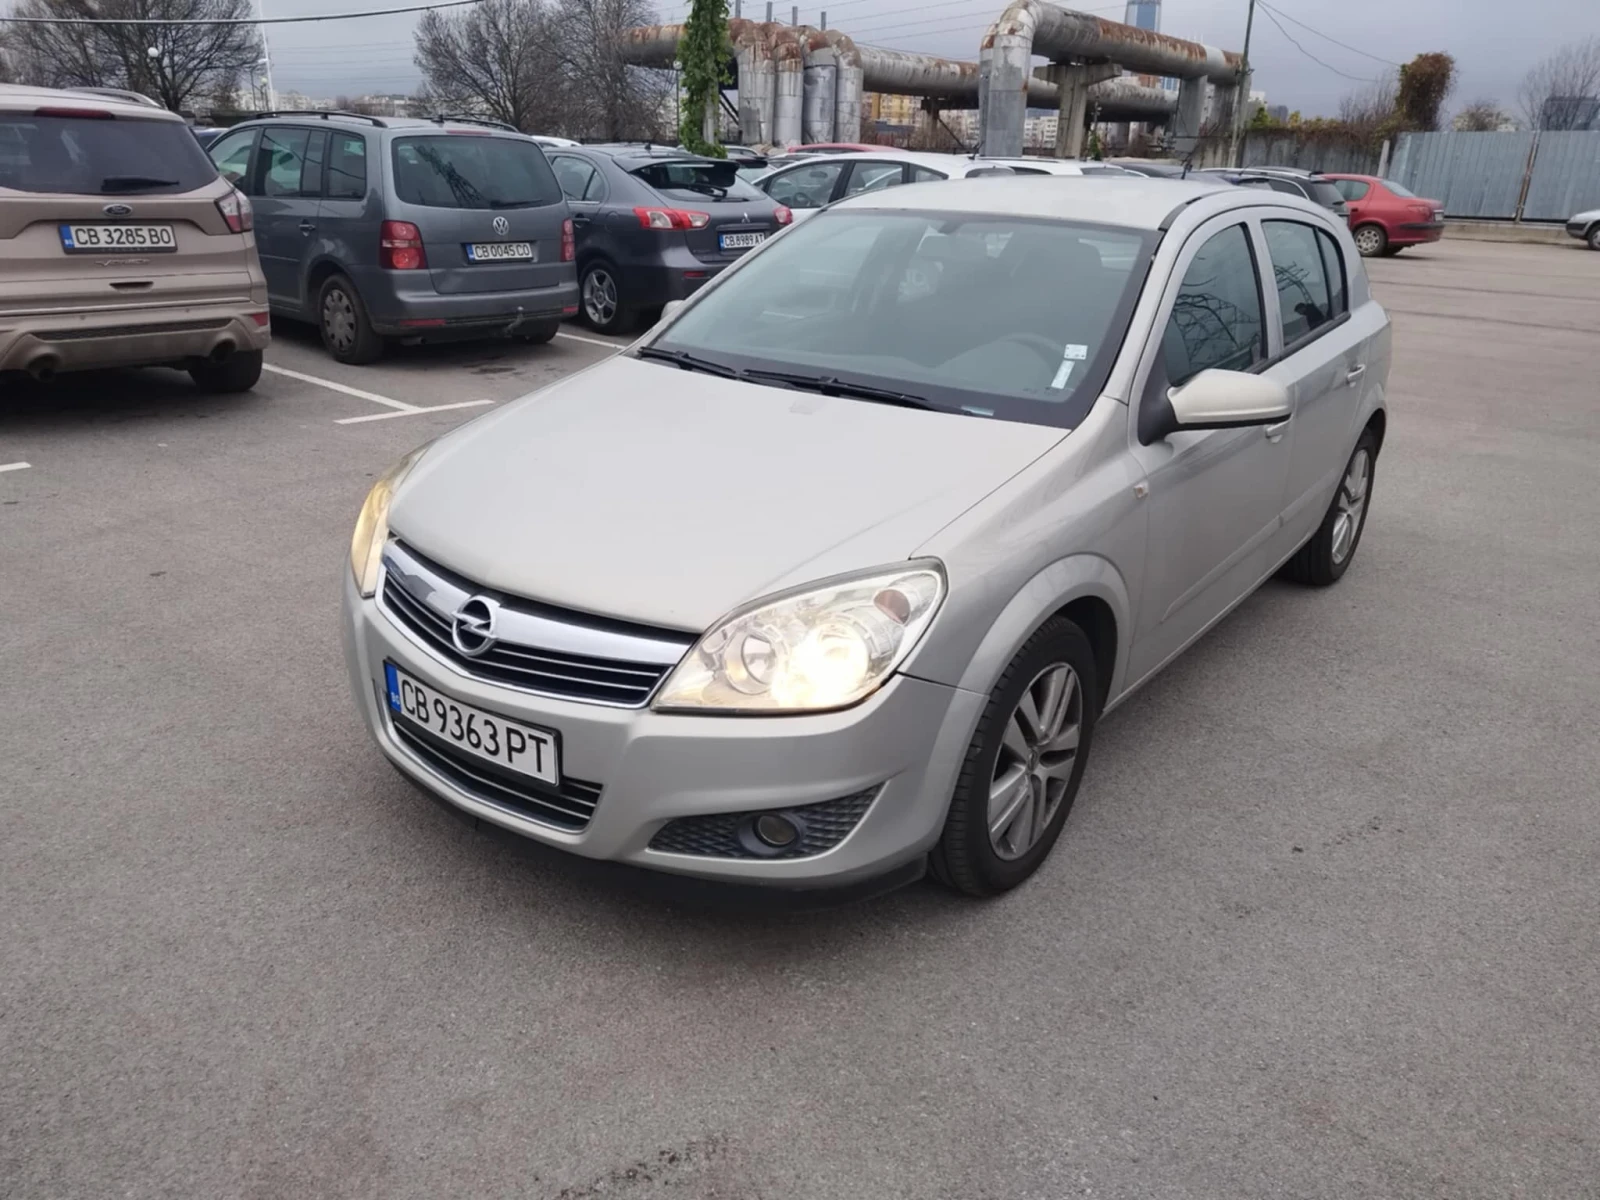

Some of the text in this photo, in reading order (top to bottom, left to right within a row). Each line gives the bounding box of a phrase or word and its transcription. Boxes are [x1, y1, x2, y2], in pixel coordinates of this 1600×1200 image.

[75, 228, 100, 245] CB
[103, 228, 146, 244] 3285
[148, 228, 171, 244] BO
[725, 235, 735, 246] CB
[475, 244, 530, 258] CB 0045 CO
[401, 679, 549, 774] CB 9363 PT
